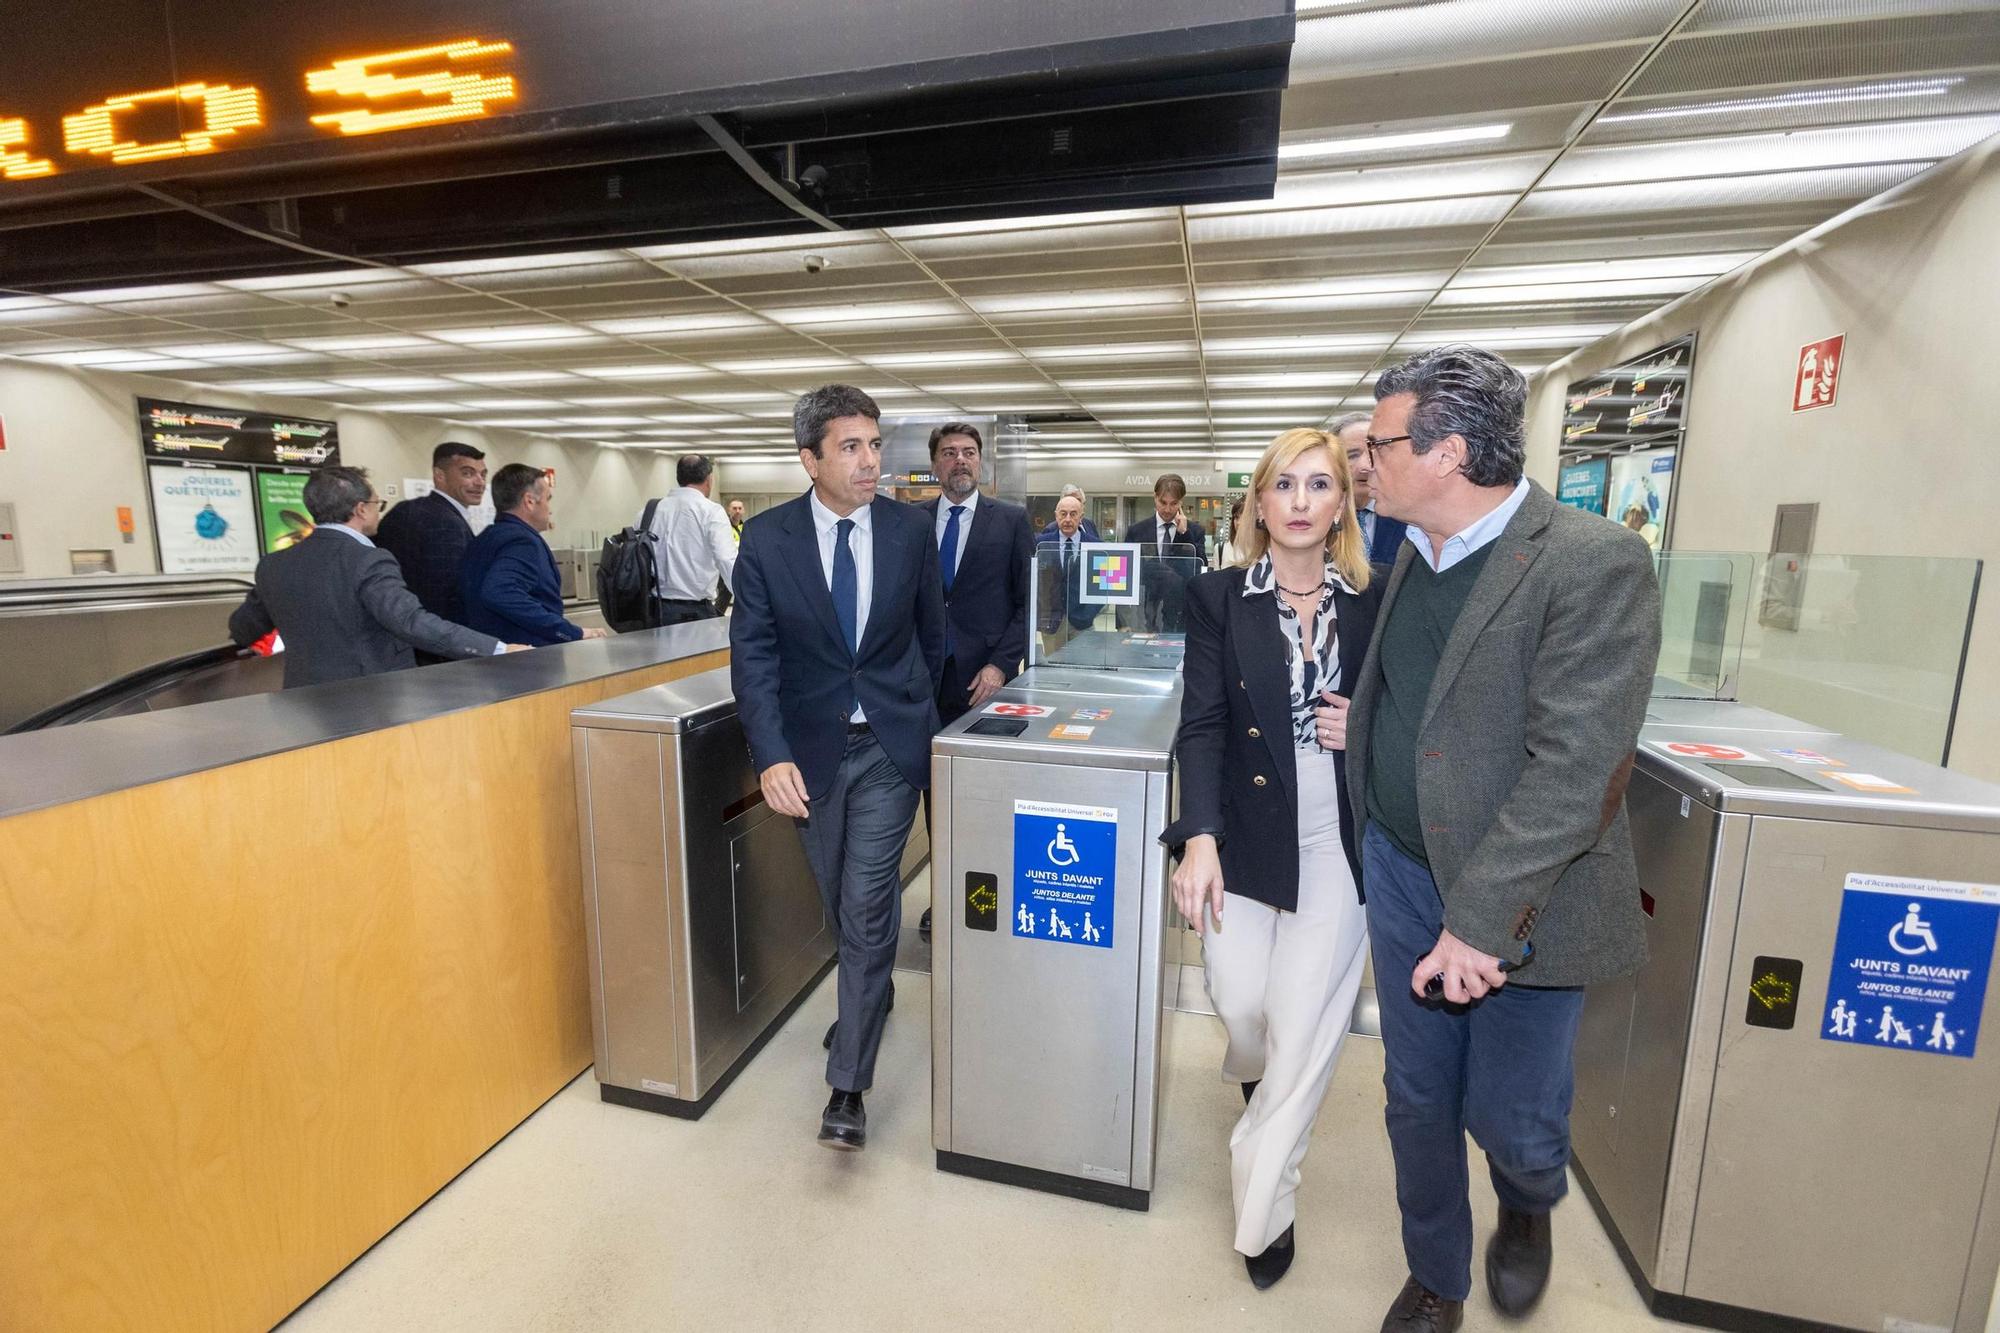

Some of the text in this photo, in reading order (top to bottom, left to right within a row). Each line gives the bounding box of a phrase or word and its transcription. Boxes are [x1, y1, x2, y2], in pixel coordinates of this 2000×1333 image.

[164, 486, 191, 496] QUE
[1025, 869, 1058, 881] JUNTS
[1062, 873, 1104, 885] DAVANT
[1032, 888, 1060, 898] JUNTOS
[1061, 891, 1096, 902] DELANTE
[1926, 884, 1967, 895] Universal
[1850, 958, 1900, 973] JUNTS
[1907, 963, 1971, 981] DAVANT
[1857, 981, 1901, 994] JUNTOS
[1902, 986, 1956, 1000] DELANTE
